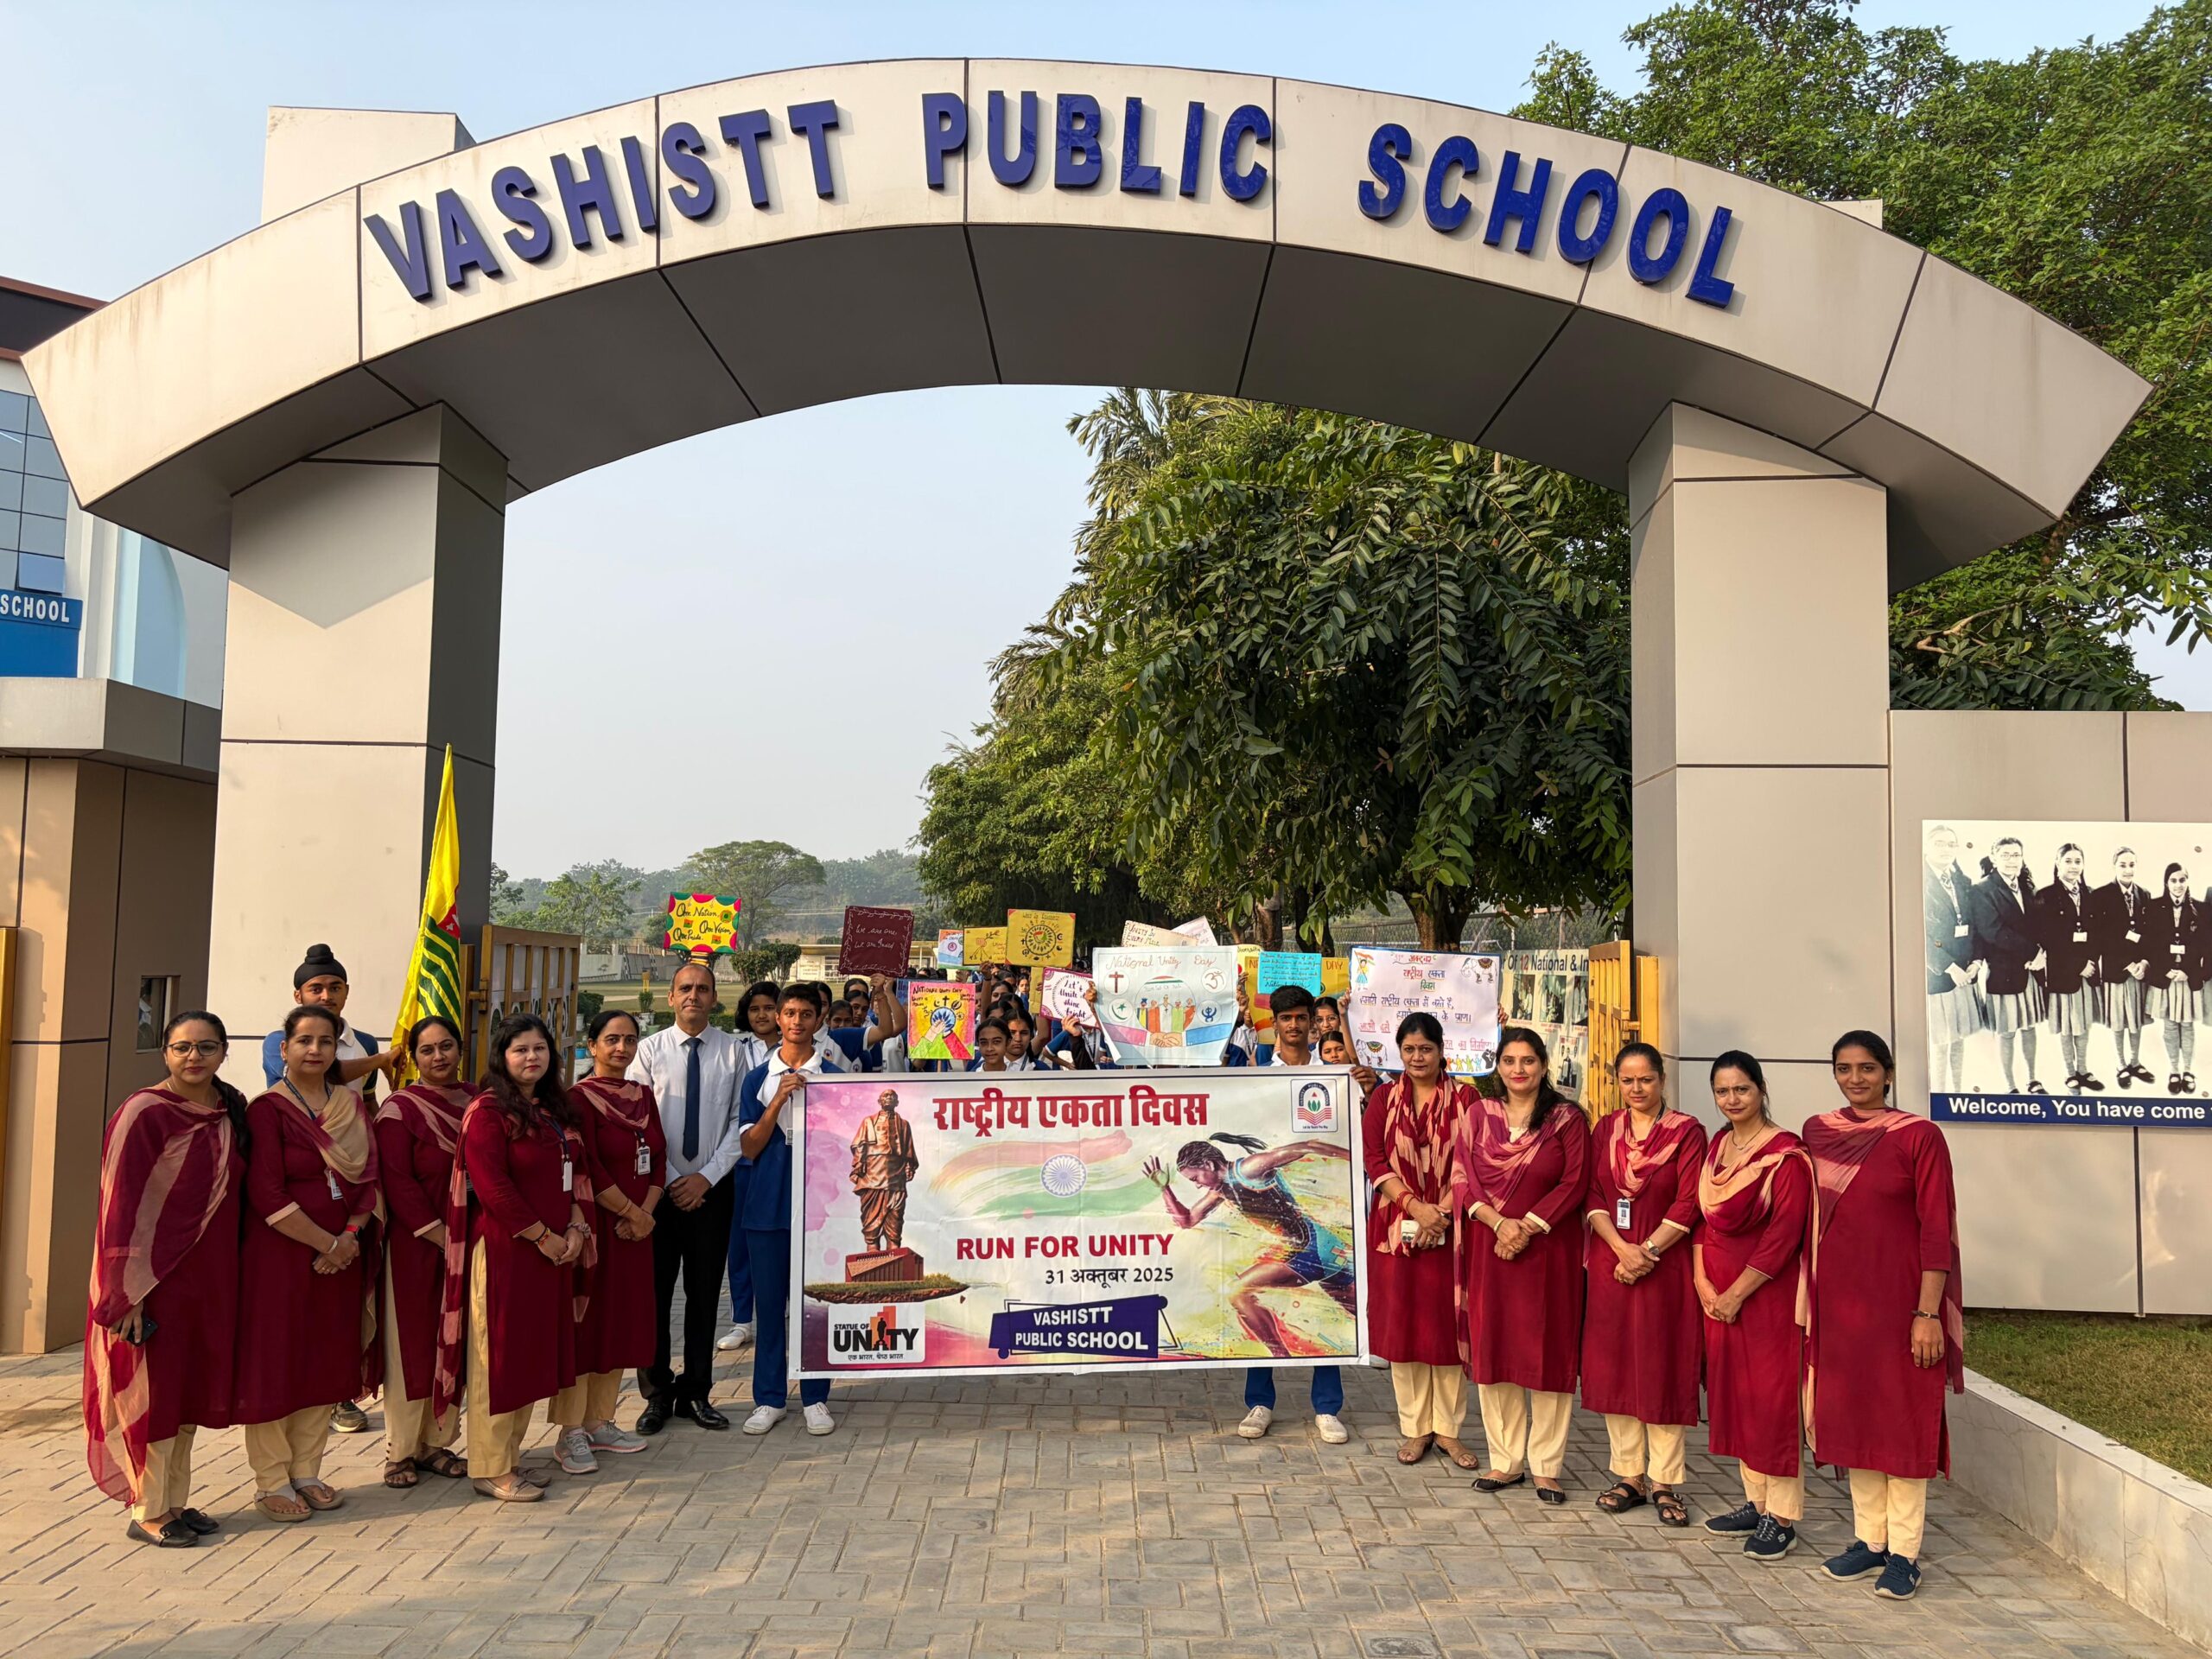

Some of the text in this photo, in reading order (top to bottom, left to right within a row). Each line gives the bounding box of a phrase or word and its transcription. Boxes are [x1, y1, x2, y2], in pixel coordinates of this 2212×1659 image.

[364, 90, 1735, 308] VASHISTT PUBLIC SCHOOL
[0, 594, 70, 623] SCHOOL
[1106, 955, 1217, 969] National Unity Day
[1325, 960, 1343, 969] DAY
[1508, 954, 1518, 970] Of
[1520, 955, 1529, 971] 12
[1531, 954, 1567, 971] National
[1570, 955, 1577, 971] &
[933, 1084, 1210, 1137] राष्ट्रीय एकता दिवस
[1948, 1097, 2047, 1118] Welcome,
[2052, 1099, 2091, 1116] You
[2097, 1102, 2145, 1118] have
[2151, 1105, 2206, 1119] come
[957, 1234, 1174, 1260] RUN FOR UNITY
[1046, 1268, 1174, 1288] 31 अक्तूबर 2025
[1033, 1306, 1113, 1325] VASHISTT
[1015, 1332, 1149, 1350] PUBLIC SCHOOL
